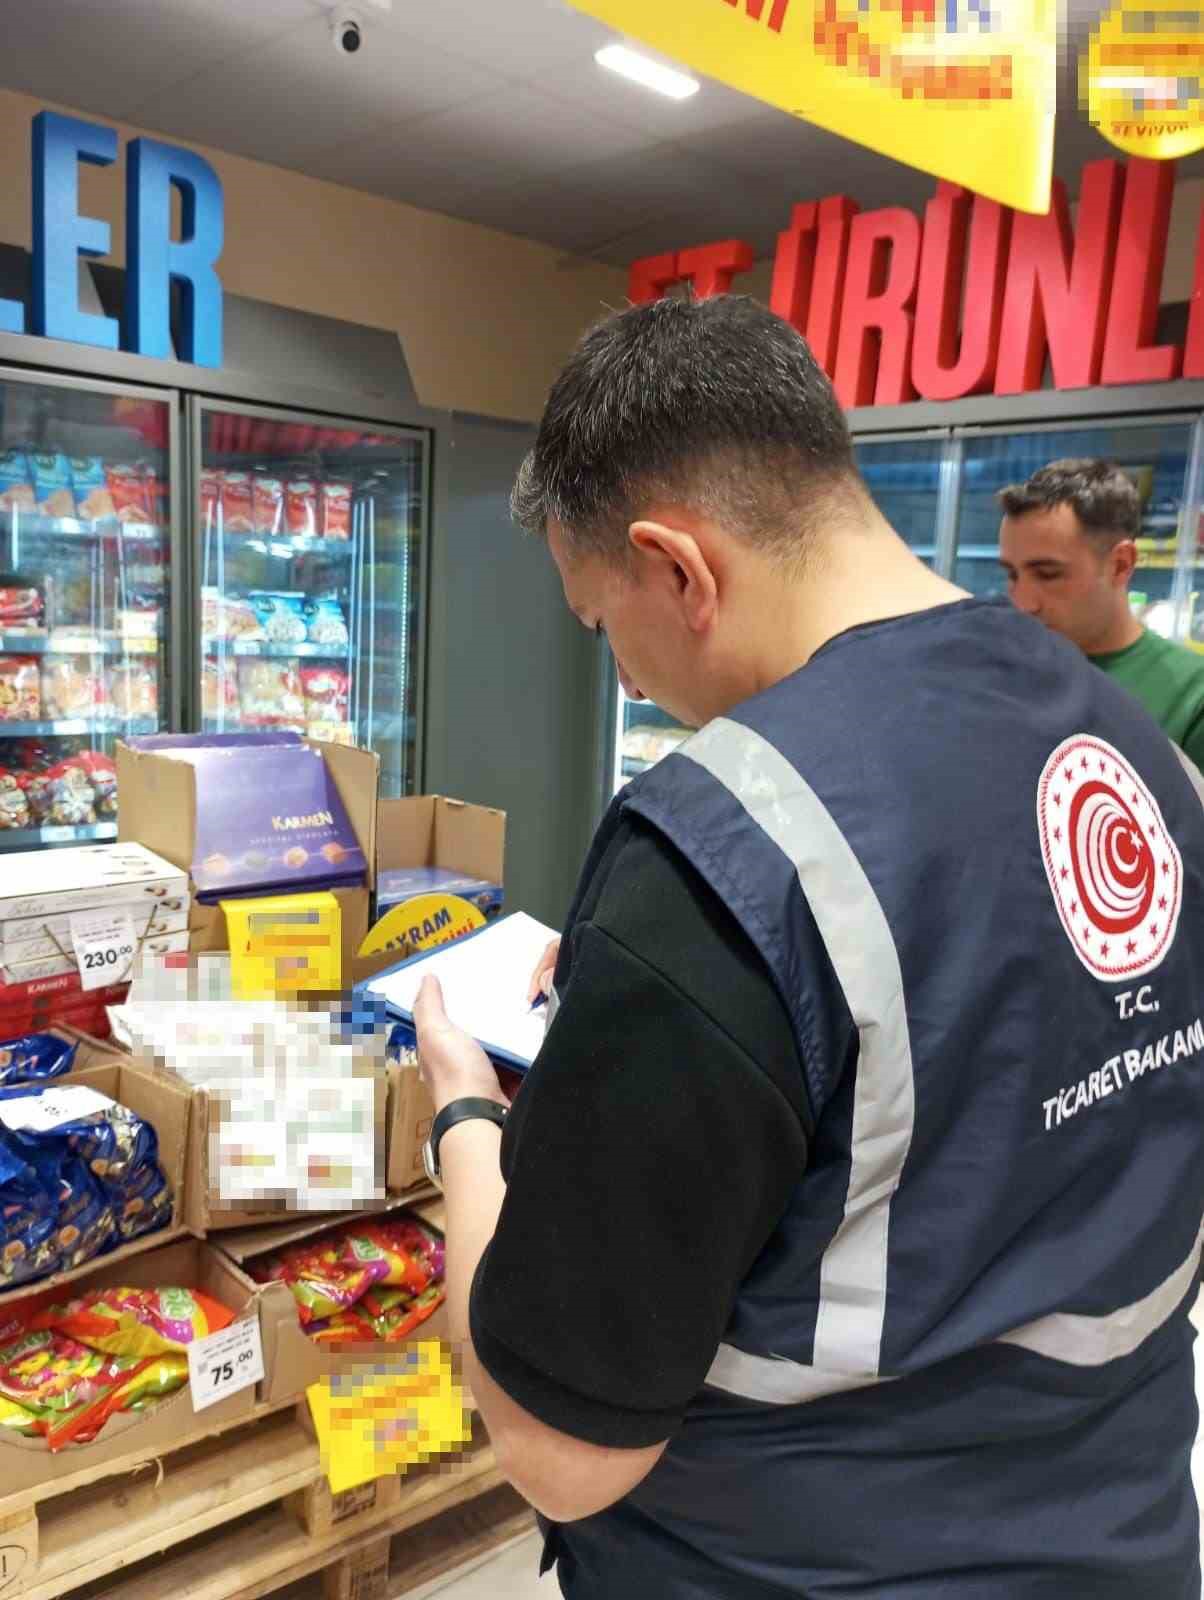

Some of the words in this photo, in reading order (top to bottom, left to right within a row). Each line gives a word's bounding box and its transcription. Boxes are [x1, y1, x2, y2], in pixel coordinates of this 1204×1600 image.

[769, 158, 1204, 409] ÜRÜNL
[370, 906, 454, 955] AYRAM
[1115, 985, 1160, 1020] T.C.
[1043, 1056, 1123, 1131] TİCARET
